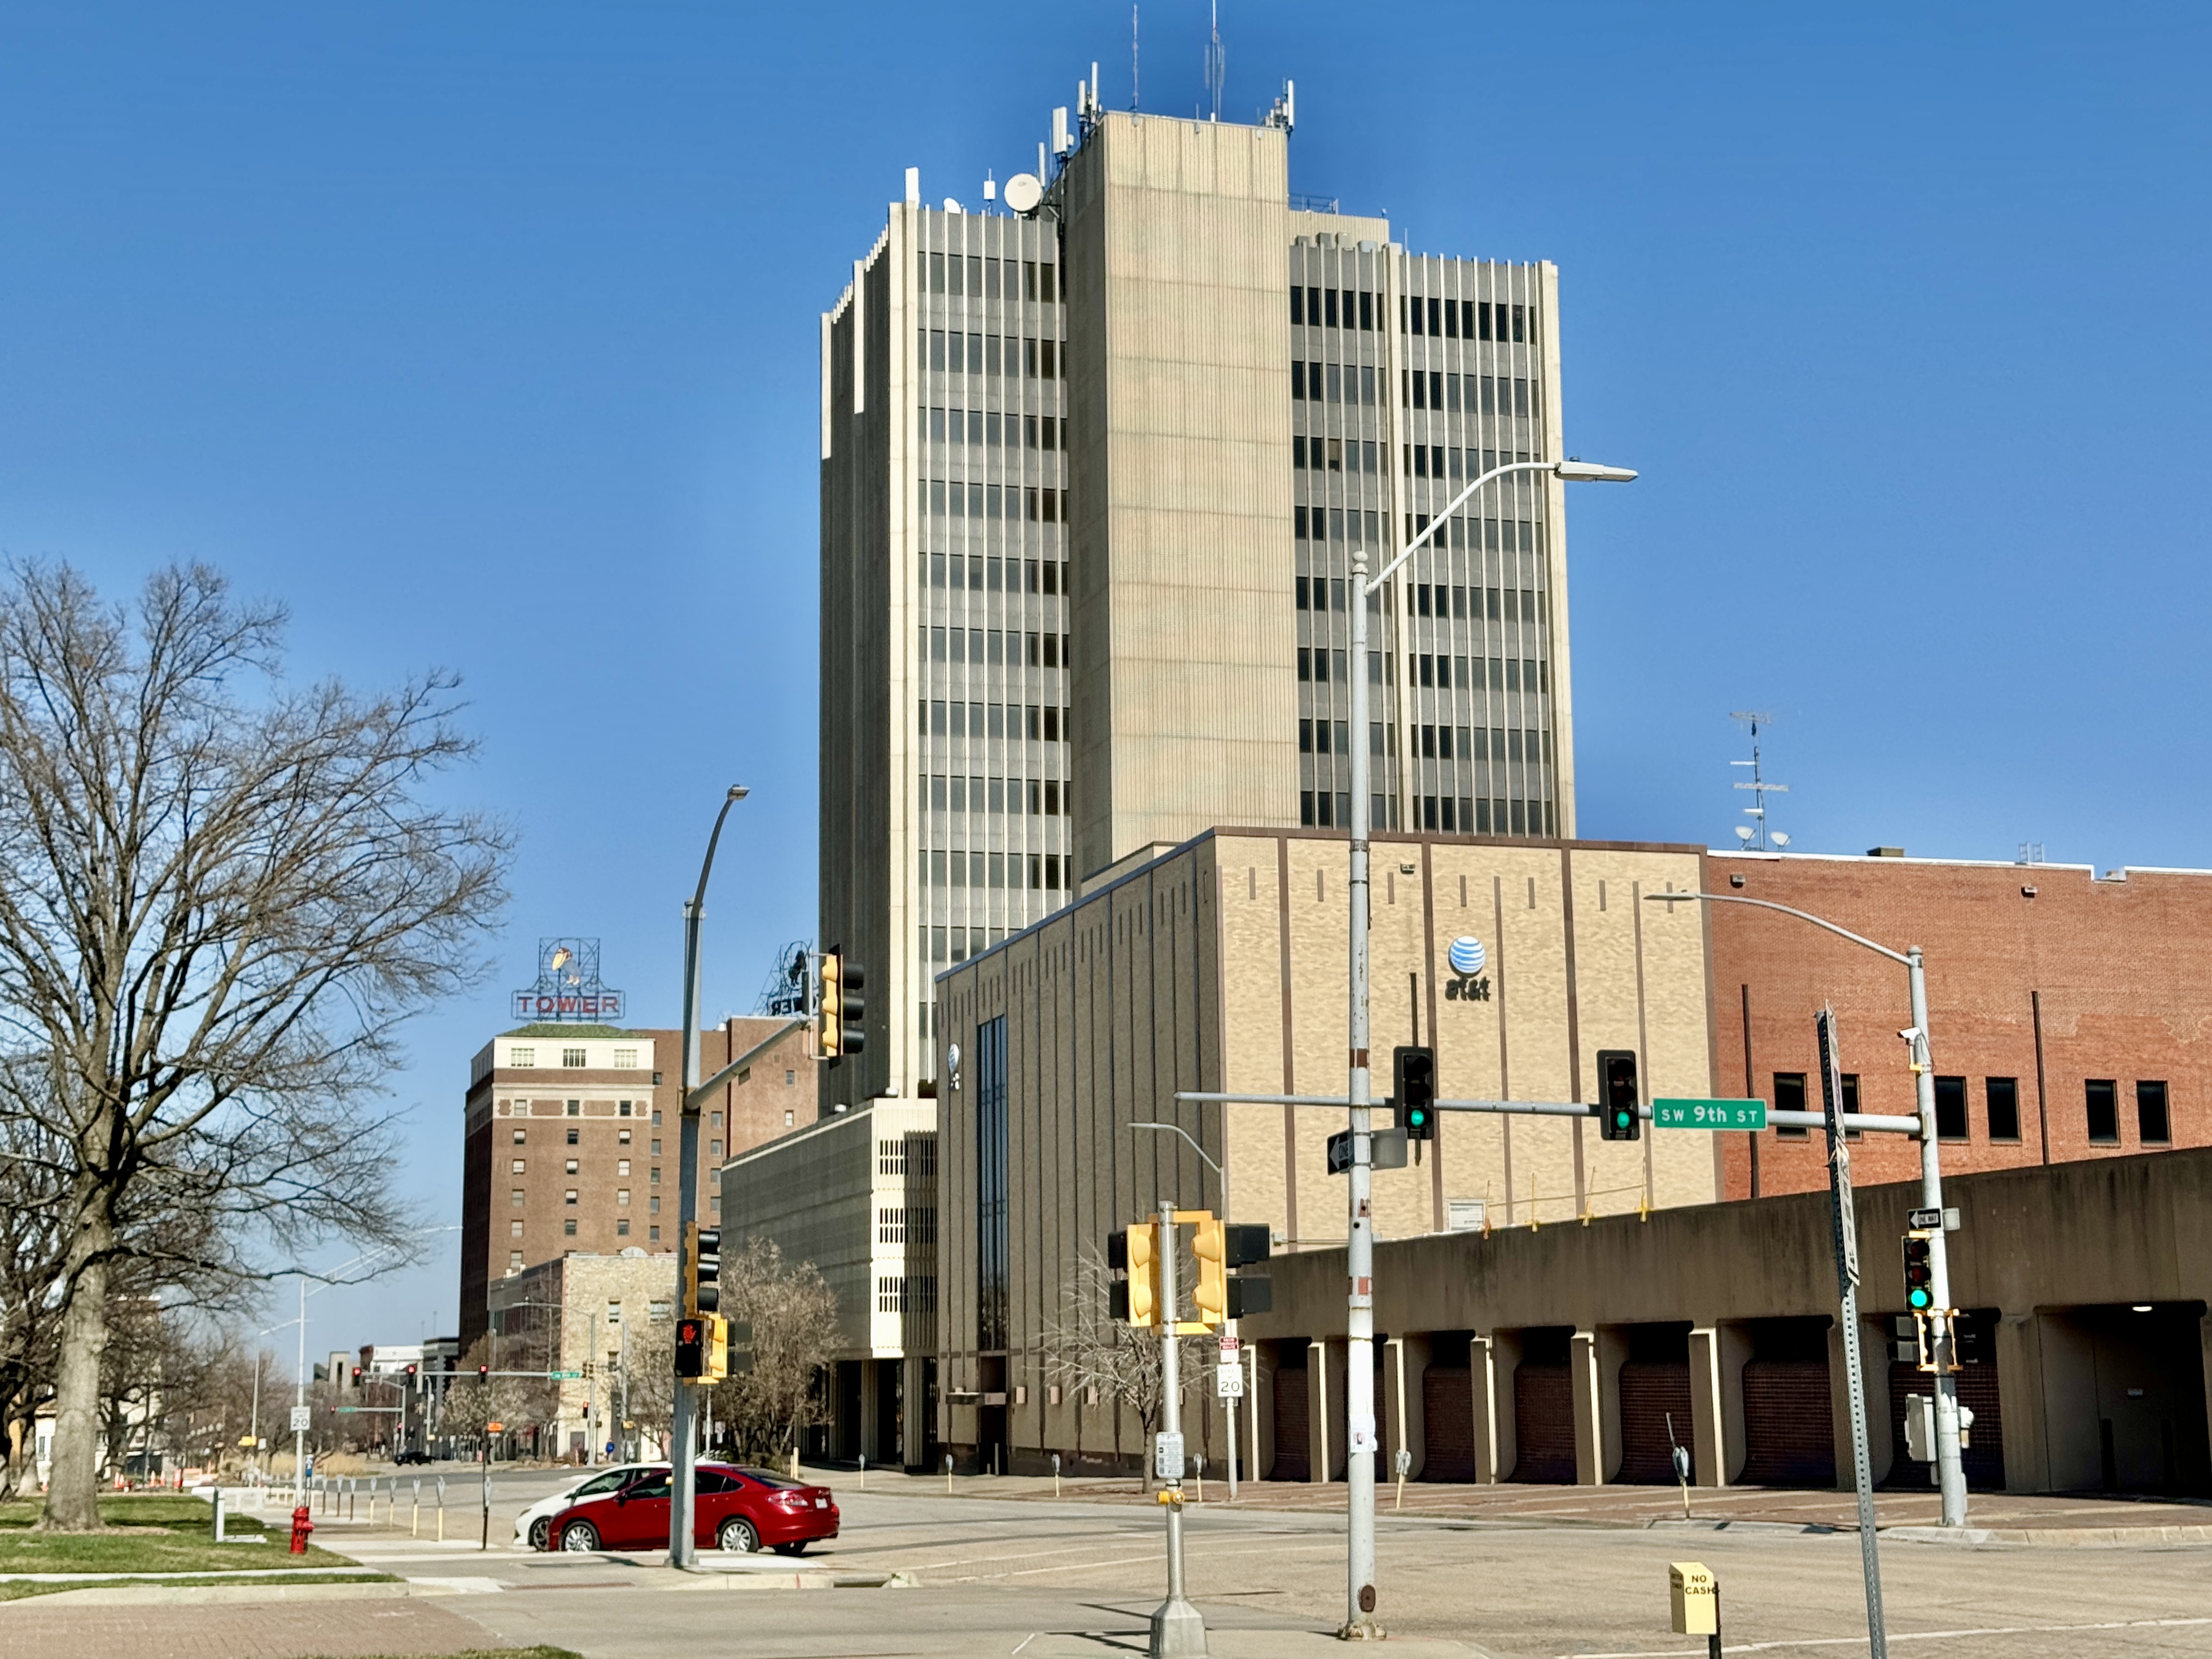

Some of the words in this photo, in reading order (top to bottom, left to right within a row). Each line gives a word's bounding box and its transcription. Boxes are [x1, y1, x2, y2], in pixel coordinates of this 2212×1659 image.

[517, 996, 619, 1012] TOWER
[1662, 1108, 1684, 1122] SW
[1694, 1105, 1727, 1123] 9th
[1737, 1110, 1758, 1123] ST
[1221, 1381, 1240, 1392] 20
[292, 1418, 308, 1427] 20
[1691, 1574, 1707, 1583] NO
[1685, 1586, 1715, 1595] CASH
